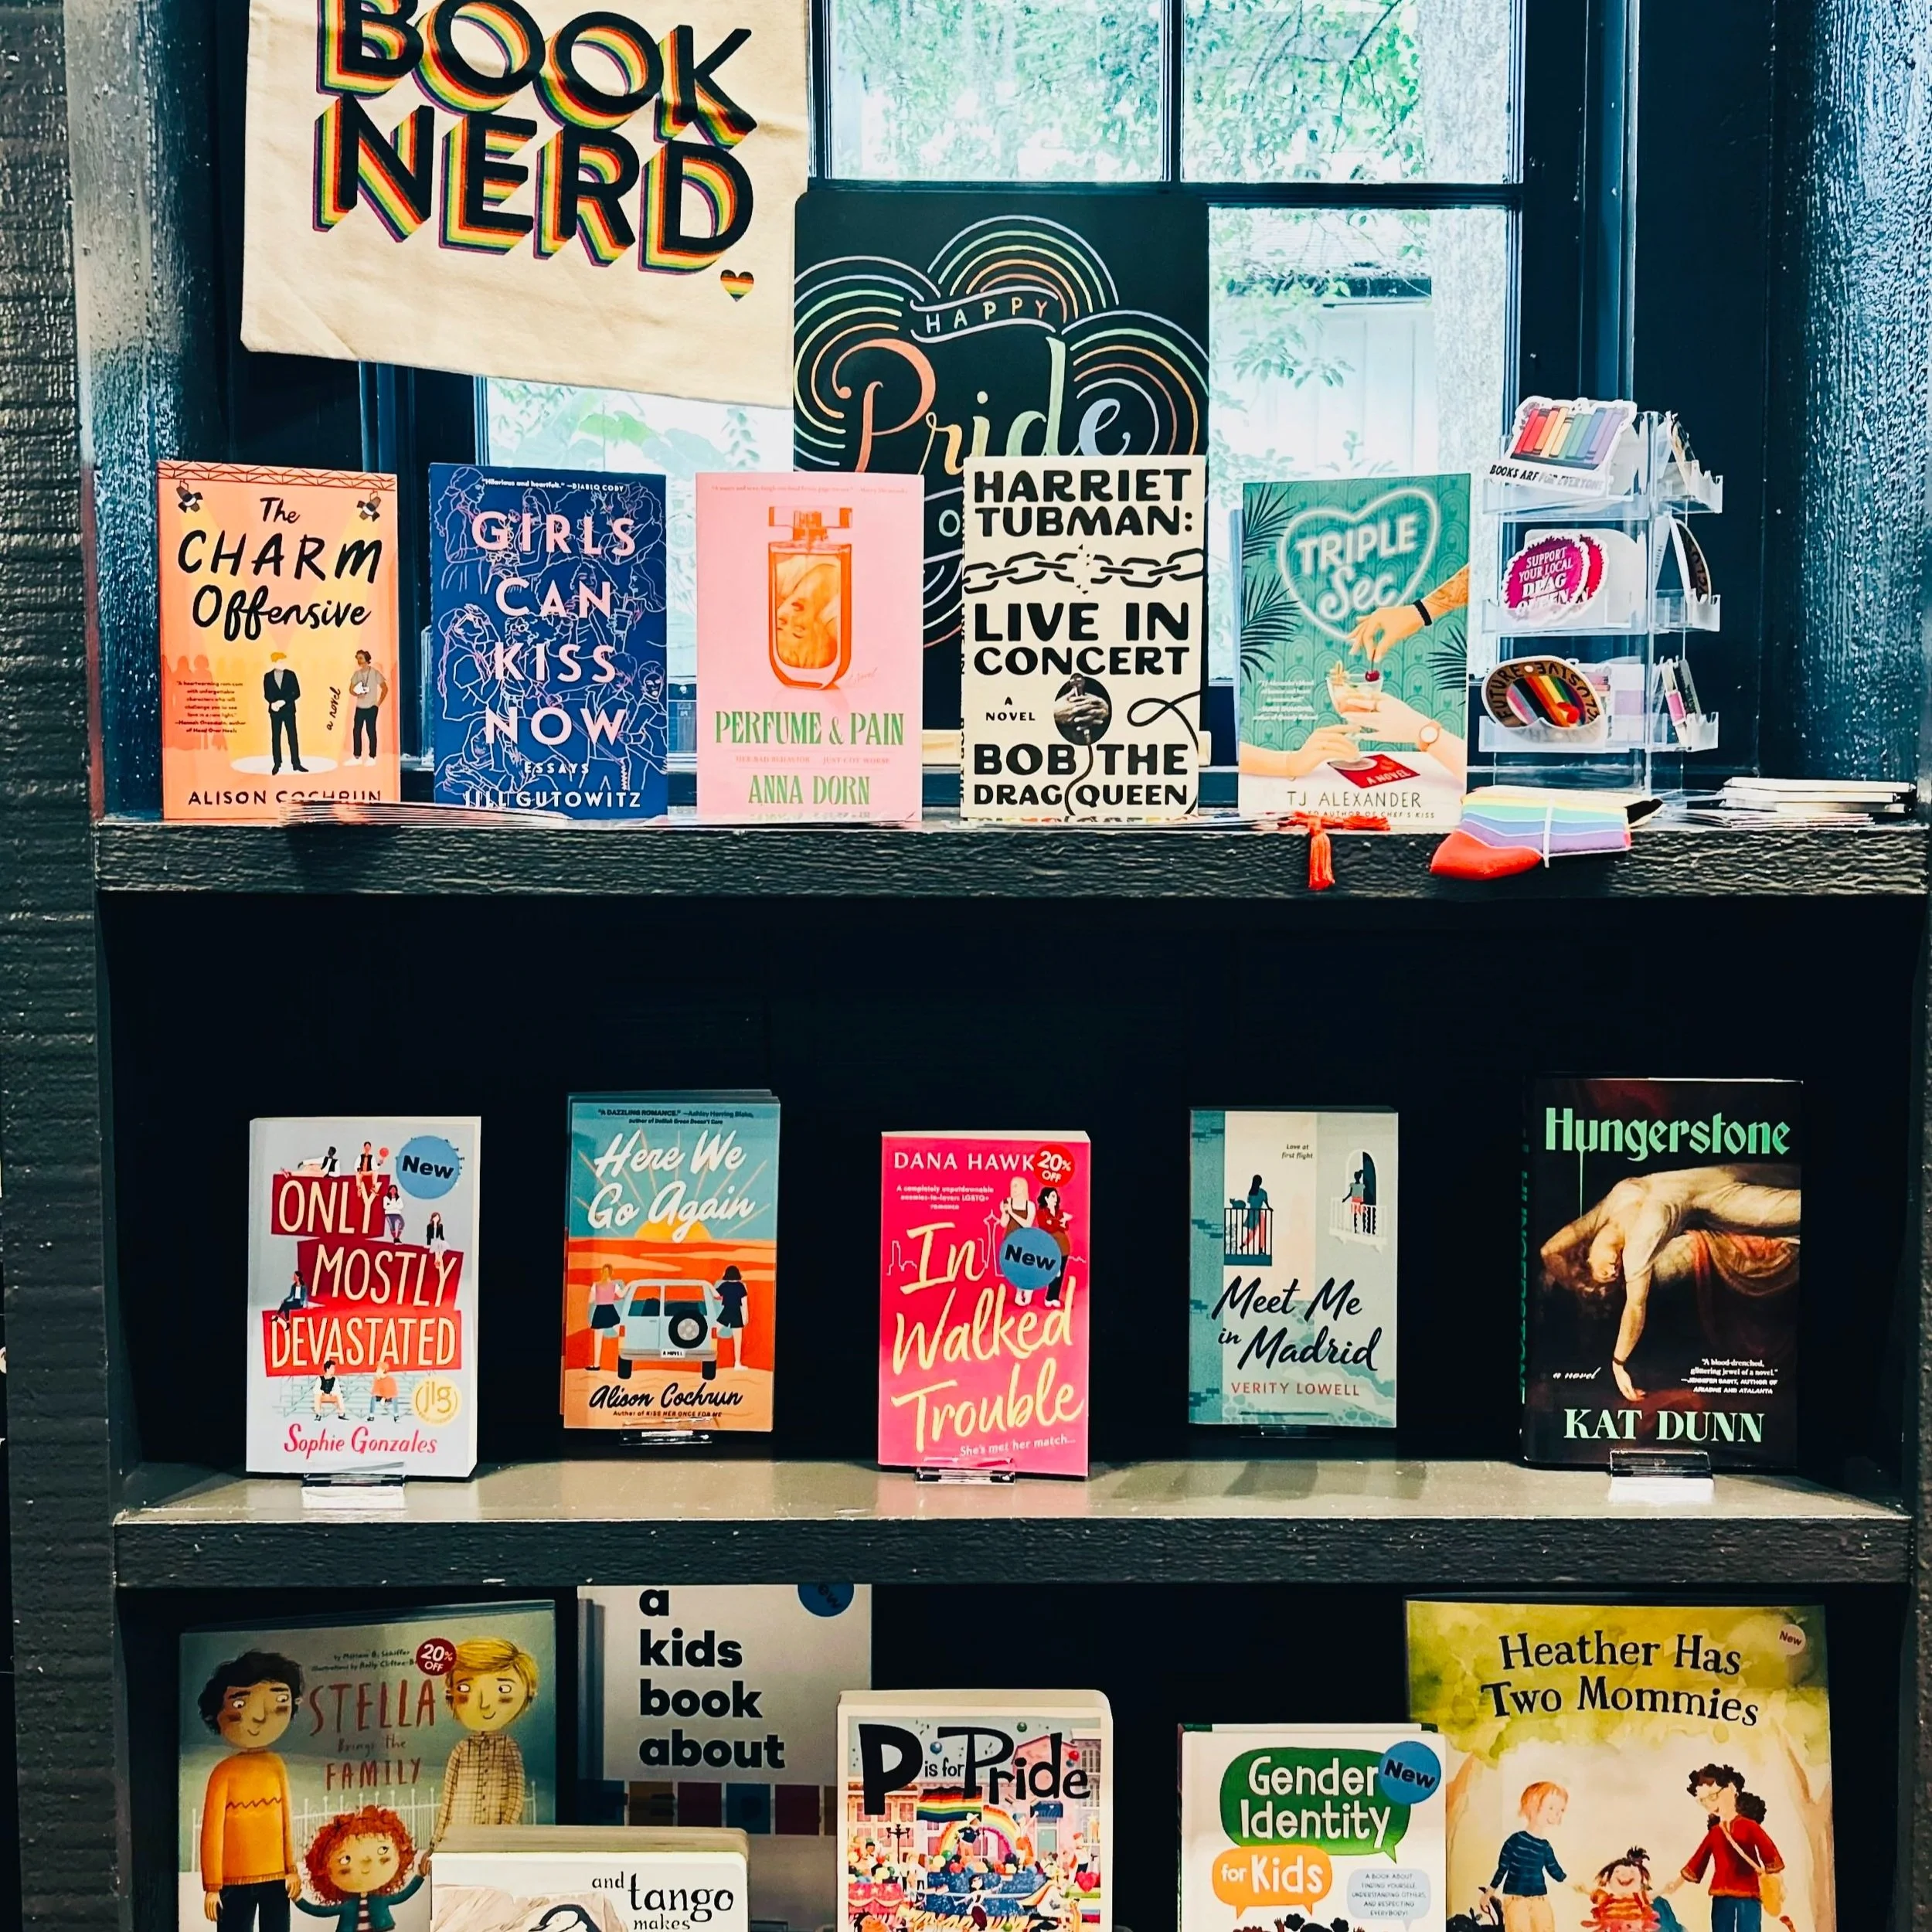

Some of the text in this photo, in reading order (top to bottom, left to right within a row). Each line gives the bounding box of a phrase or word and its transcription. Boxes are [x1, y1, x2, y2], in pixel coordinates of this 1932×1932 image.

[317, 0, 757, 150] BOOK
[313, 95, 753, 274] NERD
[926, 296, 1048, 334] HAPPY
[832, 336, 1131, 476] Pride
[974, 469, 1191, 503] HARRIET
[1489, 464, 1519, 478] BOOKS
[260, 496, 300, 524] The
[975, 505, 1192, 537] TUBMAN:
[471, 511, 636, 557] GIRLS
[1295, 513, 1419, 574] TRIPLE
[178, 529, 382, 583] CHARM
[1519, 556, 1573, 583] YOUR LOCAL
[1526, 546, 1567, 569] SUPPORT
[495, 578, 612, 619] CAN
[1320, 566, 1398, 619] Sec
[192, 584, 372, 641] Offensive
[975, 602, 1189, 641] LIVE IN
[494, 642, 617, 683] KISS
[974, 646, 1190, 675] CONCERT
[329, 687, 342, 719] novel
[1004, 696, 1012, 706] A
[1489, 664, 1525, 719] FUTURE
[485, 706, 627, 746] NOW
[715, 710, 905, 746] PERFUME & PAIN
[985, 711, 1036, 722] NOVEL
[524, 762, 590, 774] ESSAYS
[974, 743, 1188, 775] BOB THE
[748, 775, 871, 804] ANNA DORN
[1366, 769, 1410, 786] A NOVEL
[188, 791, 266, 804] ALISON
[464, 791, 641, 808] JILL GUTOWITZ
[974, 784, 1187, 808] DRAG QUEEN
[1287, 791, 1422, 808] TJ ALEXANDER
[1546, 1107, 1791, 1162] Hungerstone
[401, 1155, 454, 1180] New
[594, 1130, 748, 1179] Here We
[894, 1151, 958, 1170] DANA
[1037, 1150, 1072, 1172] 20%
[1297, 1151, 1314, 1160] flight
[1041, 1171, 1062, 1182] OFF
[277, 1179, 383, 1235] ONLY
[587, 1180, 757, 1243] Go Again
[900, 1222, 985, 1295] In
[1005, 1243, 1056, 1271] New
[311, 1243, 457, 1308] MOSTLY
[1211, 1274, 1362, 1323] Meet Me
[270, 1315, 456, 1369] DEVASTATED
[892, 1275, 1077, 1376] Walked
[1217, 1325, 1383, 1372] in Madrid
[1231, 1382, 1359, 1396] VERITY LOWELL
[1565, 1367, 1601, 1379] novel
[589, 1382, 743, 1409] Alison Cochrun
[890, 1357, 1085, 1452] Trouble
[284, 1423, 438, 1460] Sophie Gonzales
[1563, 1408, 1765, 1442] KAT DUNN
[960, 1445, 986, 1457] She's
[1012, 1439, 1030, 1451] her
[639, 1588, 669, 1617] a
[421, 1644, 453, 1662] 20%
[639, 1627, 743, 1668] kids
[1498, 1630, 1741, 1675] Heather Has
[1779, 1629, 1803, 1648] New
[424, 1662, 444, 1672] OFF
[309, 1679, 436, 1736] STELLA
[639, 1679, 763, 1718] book
[1481, 1675, 1759, 1726] Two Mommies
[639, 1729, 786, 1769] about
[326, 1757, 422, 1791] FAMILY
[858, 1723, 1091, 1815] P is for Pride
[1248, 1755, 1379, 1797] Gender
[1384, 1759, 1436, 1789] New
[1240, 1798, 1391, 1849] Identity
[1221, 1854, 1324, 1893] for Kids
[592, 1870, 734, 1923] and tango
[633, 1913, 691, 1931] makes
